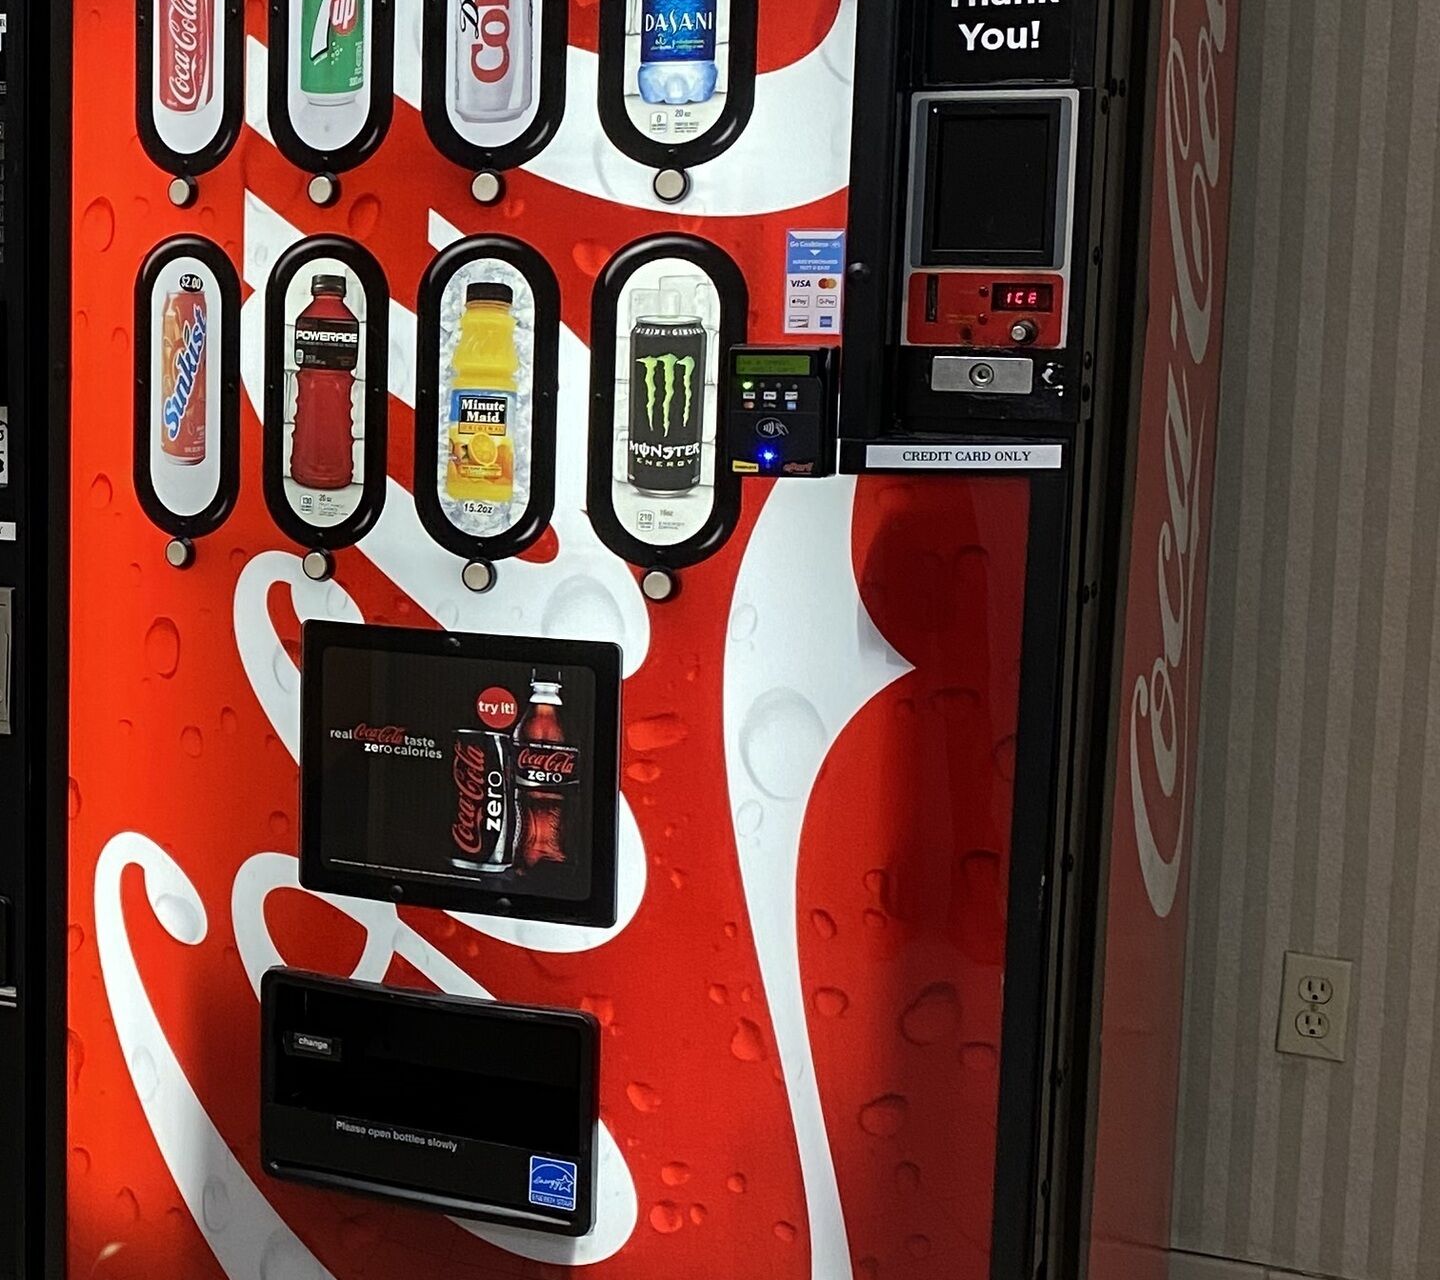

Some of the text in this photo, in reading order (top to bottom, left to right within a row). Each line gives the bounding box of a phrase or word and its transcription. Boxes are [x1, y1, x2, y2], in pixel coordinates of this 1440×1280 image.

[645, 8, 713, 35] DASANI
[958, 20, 1041, 51] You!
[180, 275, 202, 290] $2.00
[791, 279, 812, 288] VISA
[295, 330, 358, 343] POWERADE
[164, 303, 207, 441] Sunkist
[461, 399, 506, 412] Minute
[466, 411, 501, 423] Maid
[629, 440, 701, 460] MONSTER
[902, 451, 1032, 462] CREDIT CARD ONLY
[636, 457, 694, 468] ENERGY
[464, 503, 494, 515] 15.2oz
[477, 701, 516, 716] try it!
[329, 728, 353, 741] real
[403, 735, 436, 749] taste
[364, 742, 443, 760] zero calories
[527, 770, 563, 783] zero
[486, 771, 503, 833] zero
[298, 1036, 329, 1050] change
[336, 1120, 458, 1153] Please open bottles slowly
